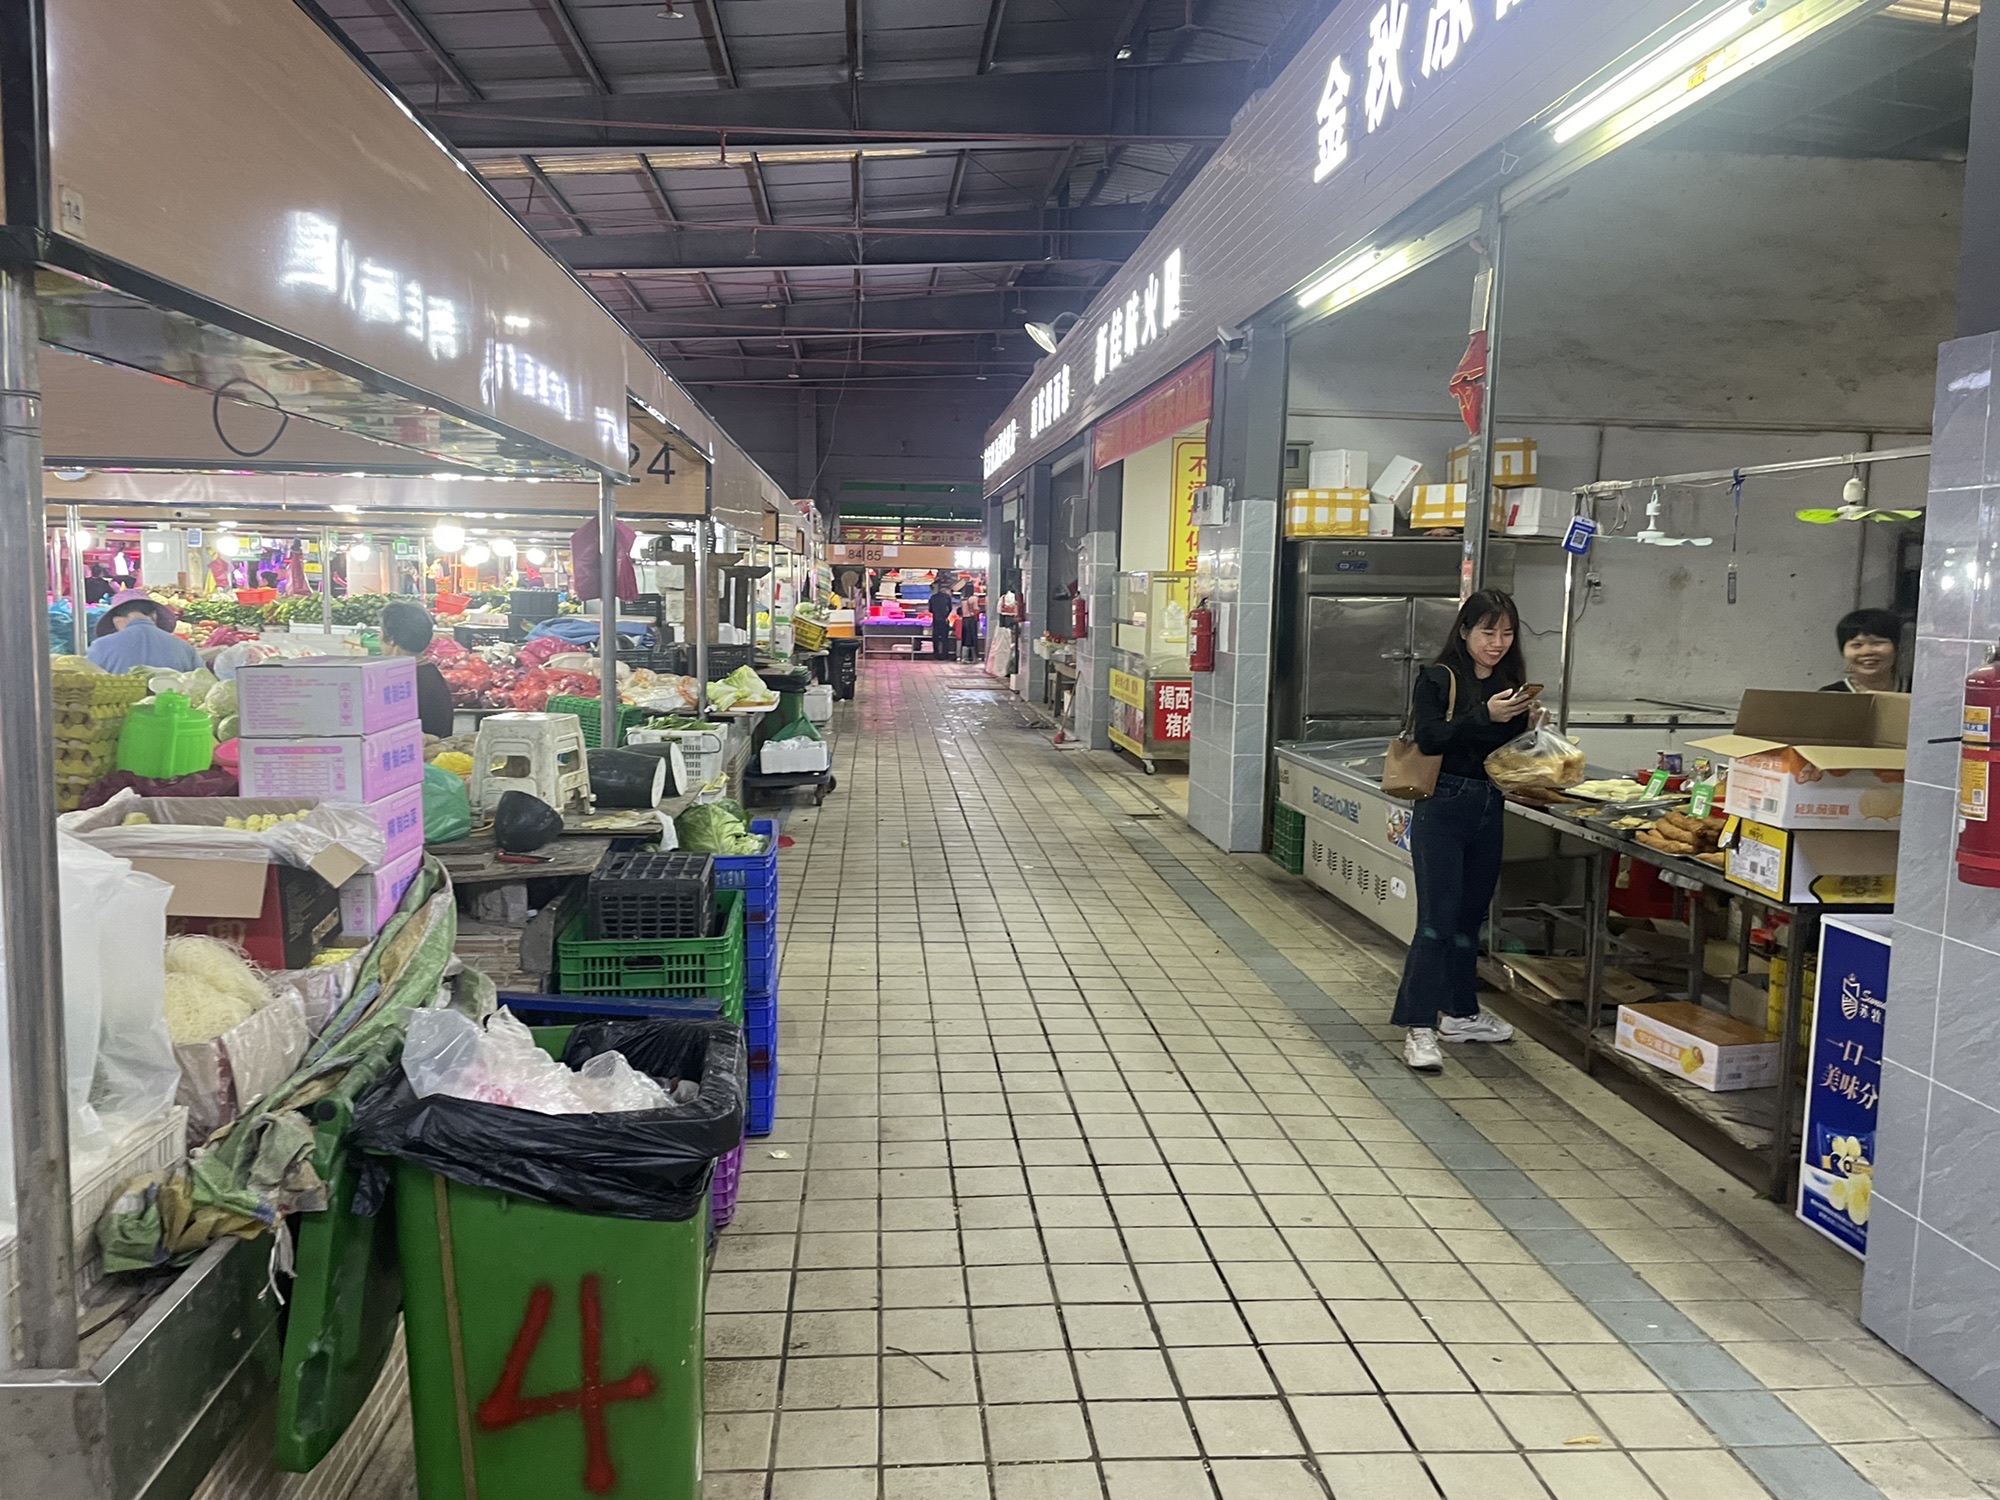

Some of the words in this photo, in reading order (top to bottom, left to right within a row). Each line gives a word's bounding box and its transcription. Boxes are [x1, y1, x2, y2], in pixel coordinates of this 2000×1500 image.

[848, 550, 863, 560] 84
[866, 550, 881, 561] 85
[1159, 685, 1193, 710] 揭西
[1820, 1063, 1879, 1110] 美味分
[476, 1272, 660, 1495] 4
